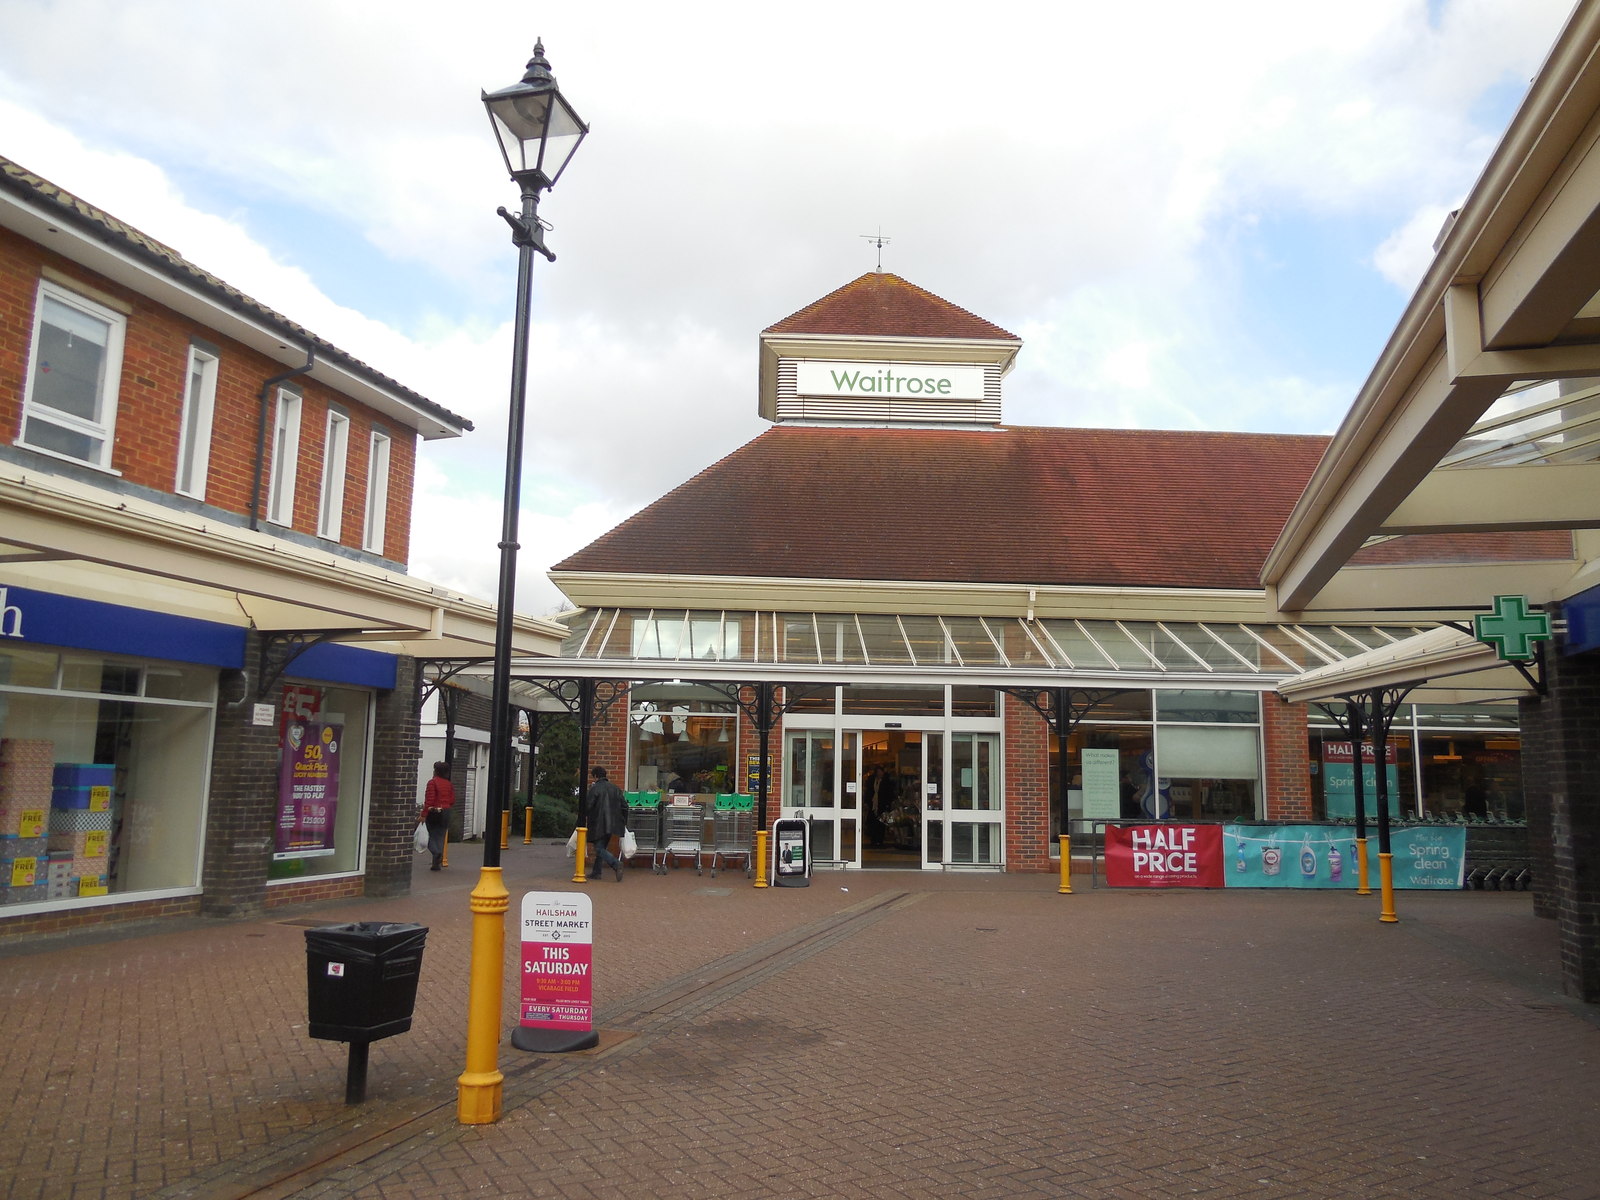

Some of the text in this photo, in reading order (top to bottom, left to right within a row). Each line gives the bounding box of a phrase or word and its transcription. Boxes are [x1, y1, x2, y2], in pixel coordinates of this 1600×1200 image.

[830, 369, 952, 394] Waitrose
[1360, 745, 1391, 756] PRE
[1329, 776, 1393, 788] Sprin cln
[1132, 828, 1196, 851] HALF
[1408, 844, 1450, 859] Spring
[1133, 852, 1197, 872] PRICE
[1414, 858, 1447, 869] clean
[1409, 875, 1454, 885] Waitrose
[536, 909, 577, 917] HAILSHAM
[525, 919, 589, 929] STREET MARKET
[542, 947, 570, 960] THIS
[524, 961, 589, 975] SATURDAY
[529, 1005, 588, 1014] EVERY SATURDAY
